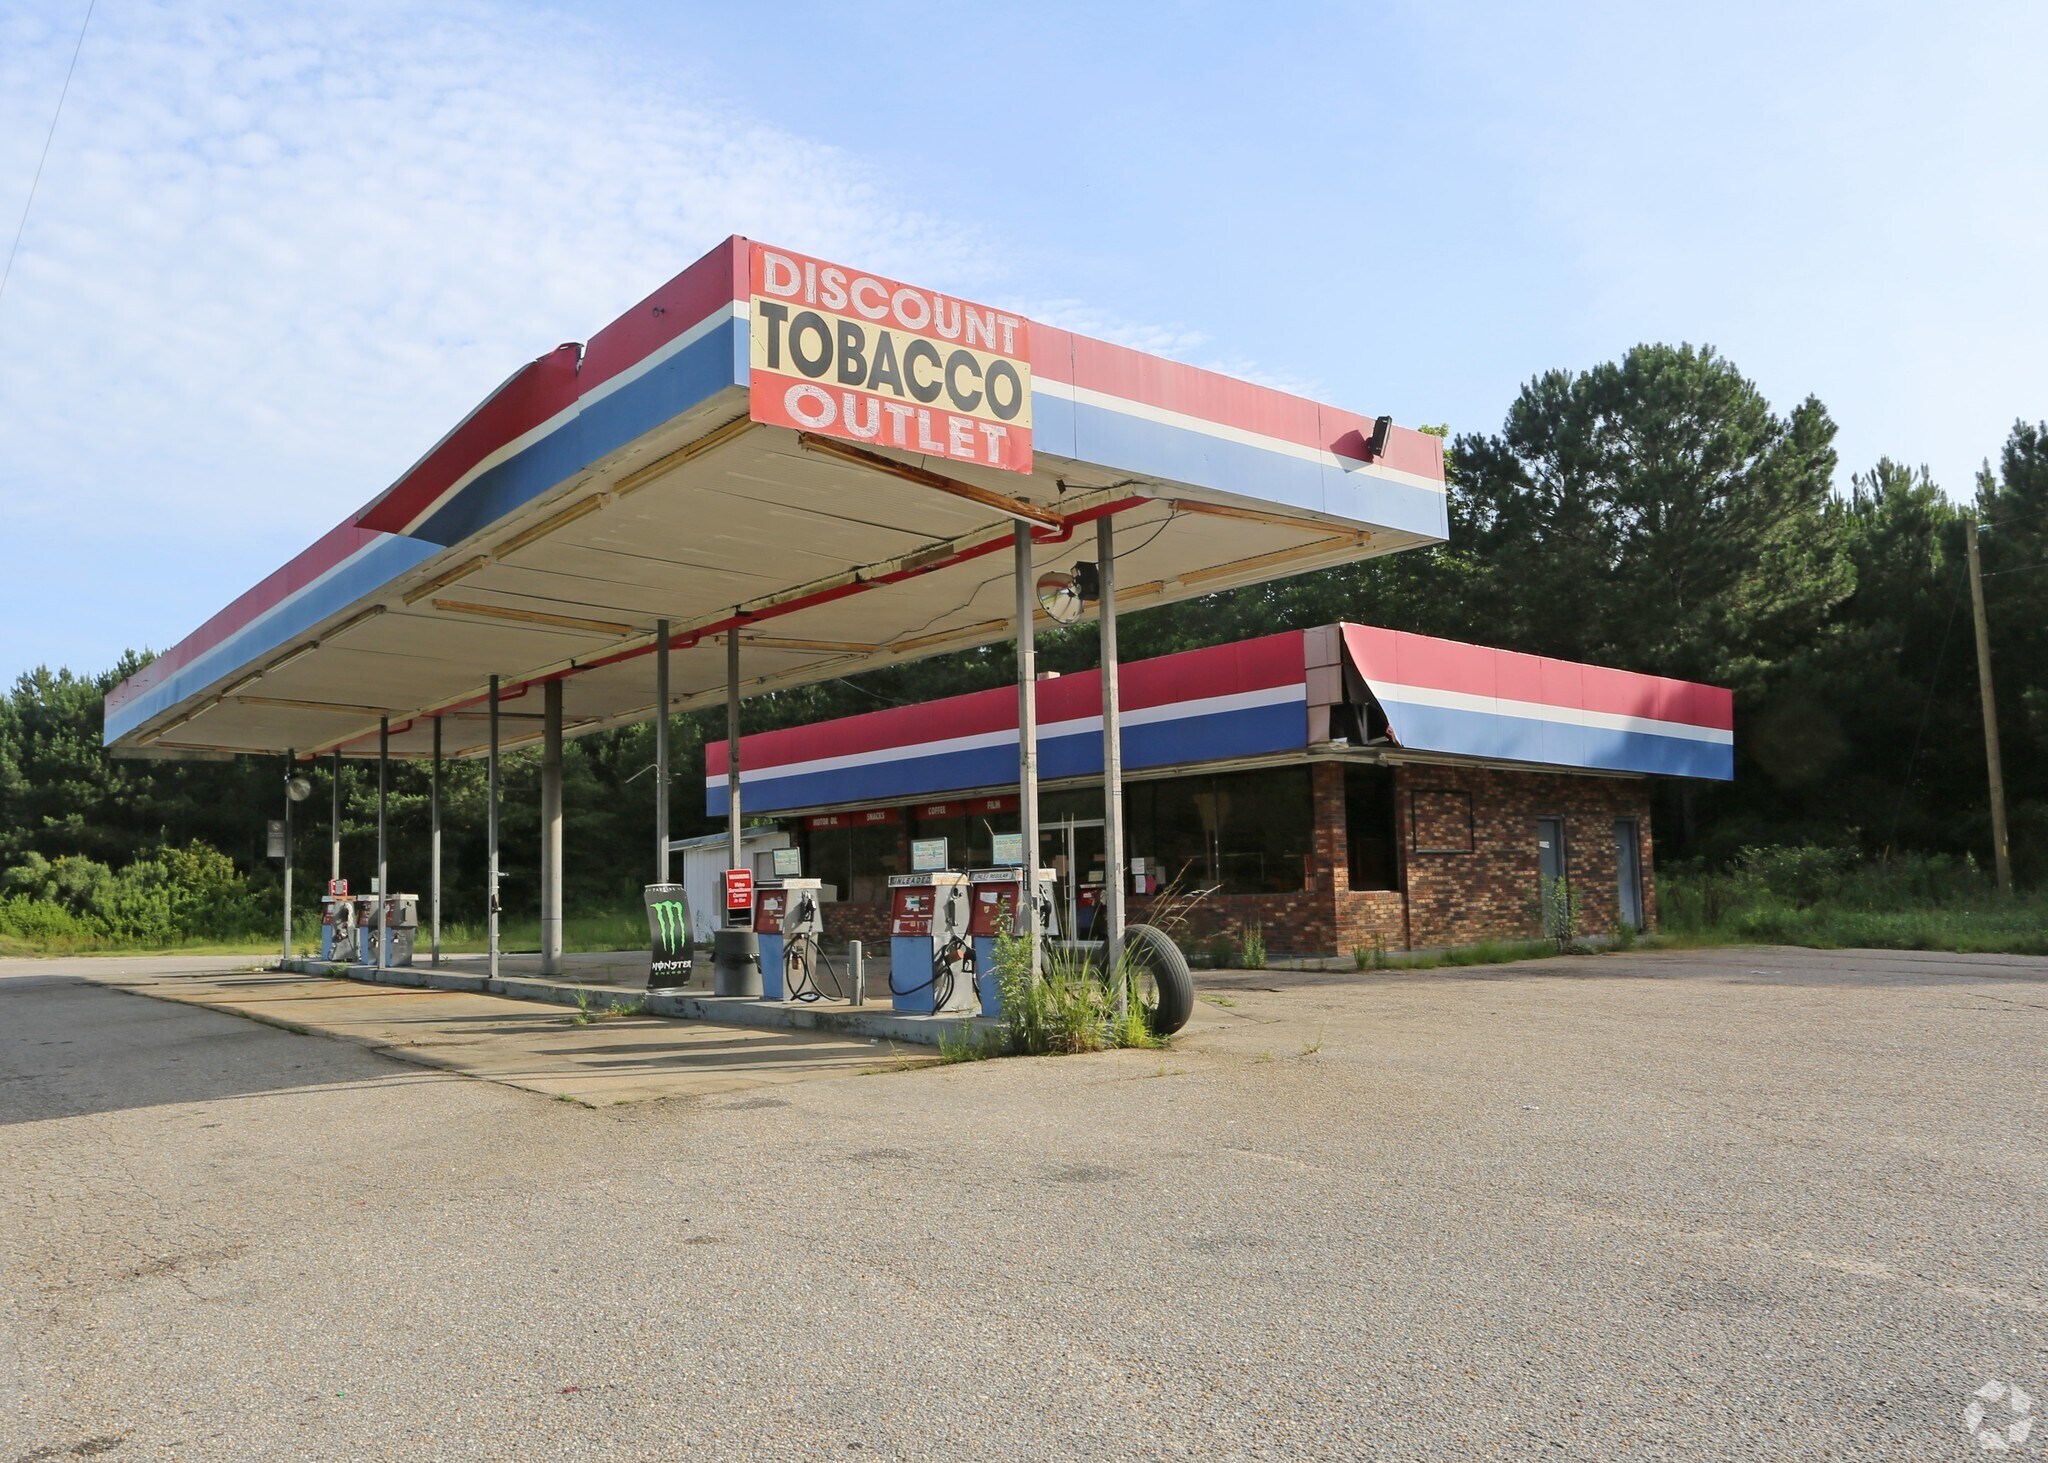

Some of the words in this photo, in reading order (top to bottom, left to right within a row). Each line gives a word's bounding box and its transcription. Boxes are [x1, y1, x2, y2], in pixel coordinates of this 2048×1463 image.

[763, 251, 1019, 354] DISCOUNT
[759, 300, 1023, 421] TOBACCO
[784, 383, 1007, 464] OUTLET
[928, 805, 946, 815] COFFEE
[813, 818, 829, 826] MOTOR
[830, 816, 838, 825] OIL
[866, 811, 885, 821] SNACKS
[891, 876, 931, 885] UNLEADED
[651, 960, 692, 971] MONSTER
